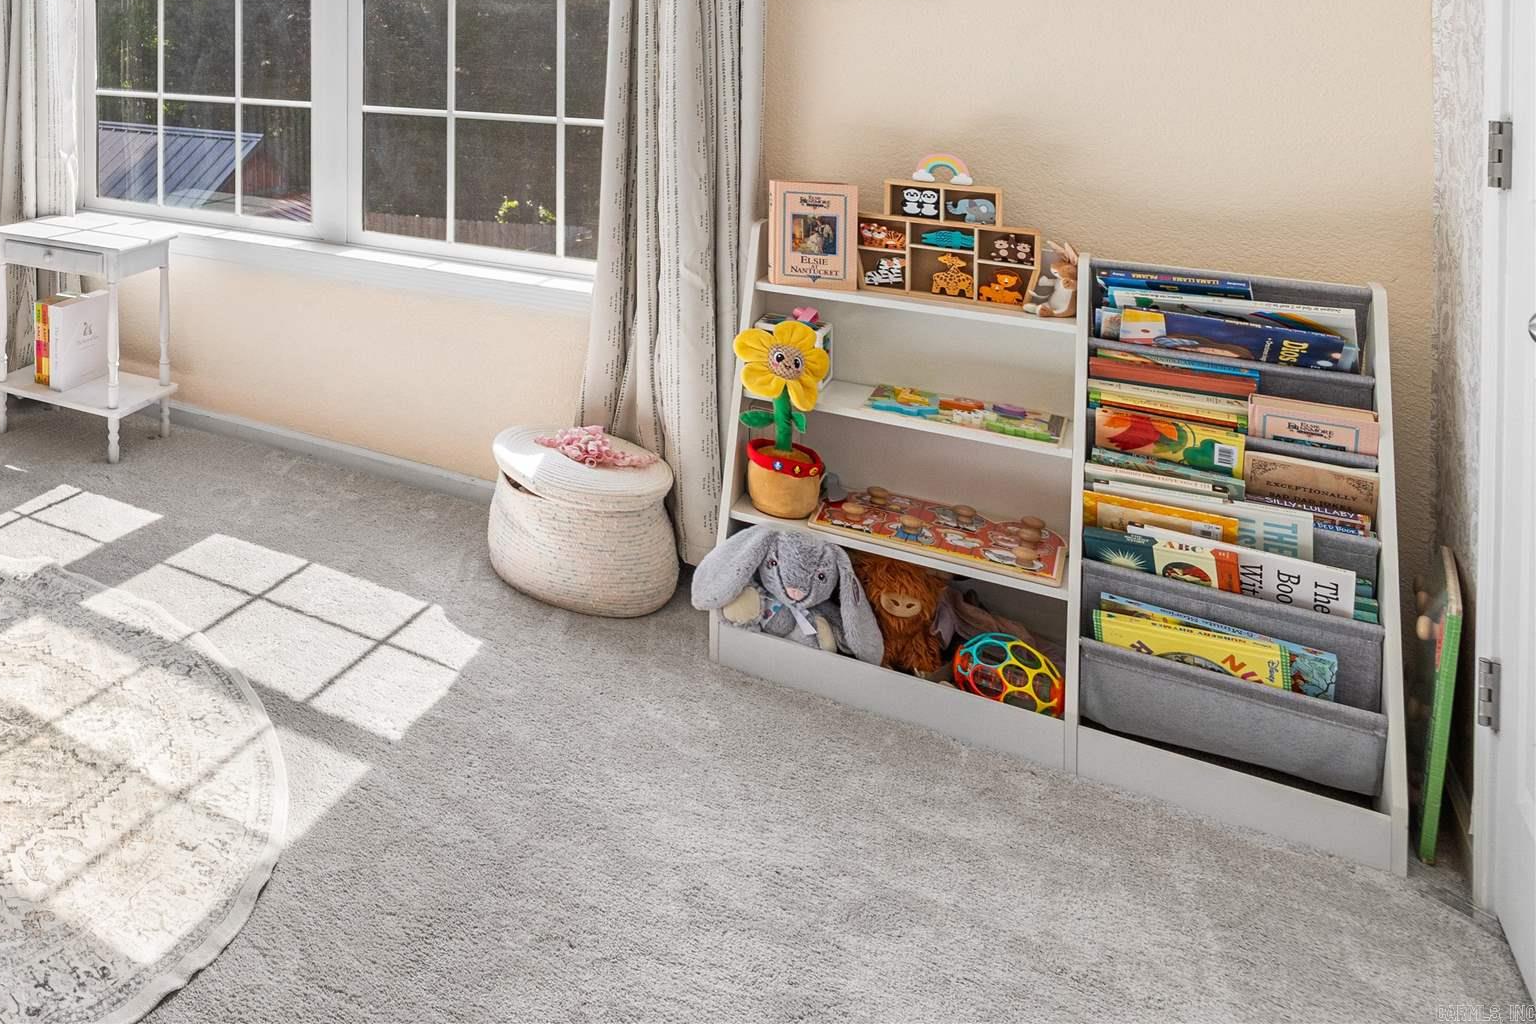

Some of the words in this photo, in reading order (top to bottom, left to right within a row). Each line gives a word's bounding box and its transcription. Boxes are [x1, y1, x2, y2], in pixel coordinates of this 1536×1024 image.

[790, 265, 840, 276] NANTUCKET
[800, 256, 829, 266] ELSIE
[1279, 340, 1309, 363] Dios
[1265, 481, 1359, 502] EXCEPTIONALLY
[1265, 496, 1297, 509] SILLY
[1303, 504, 1355, 519] LULLABY
[1263, 522, 1298, 558] THE
[1239, 563, 1264, 600] Wit
[1276, 570, 1301, 605] Boo
[1314, 581, 1339, 614] The
